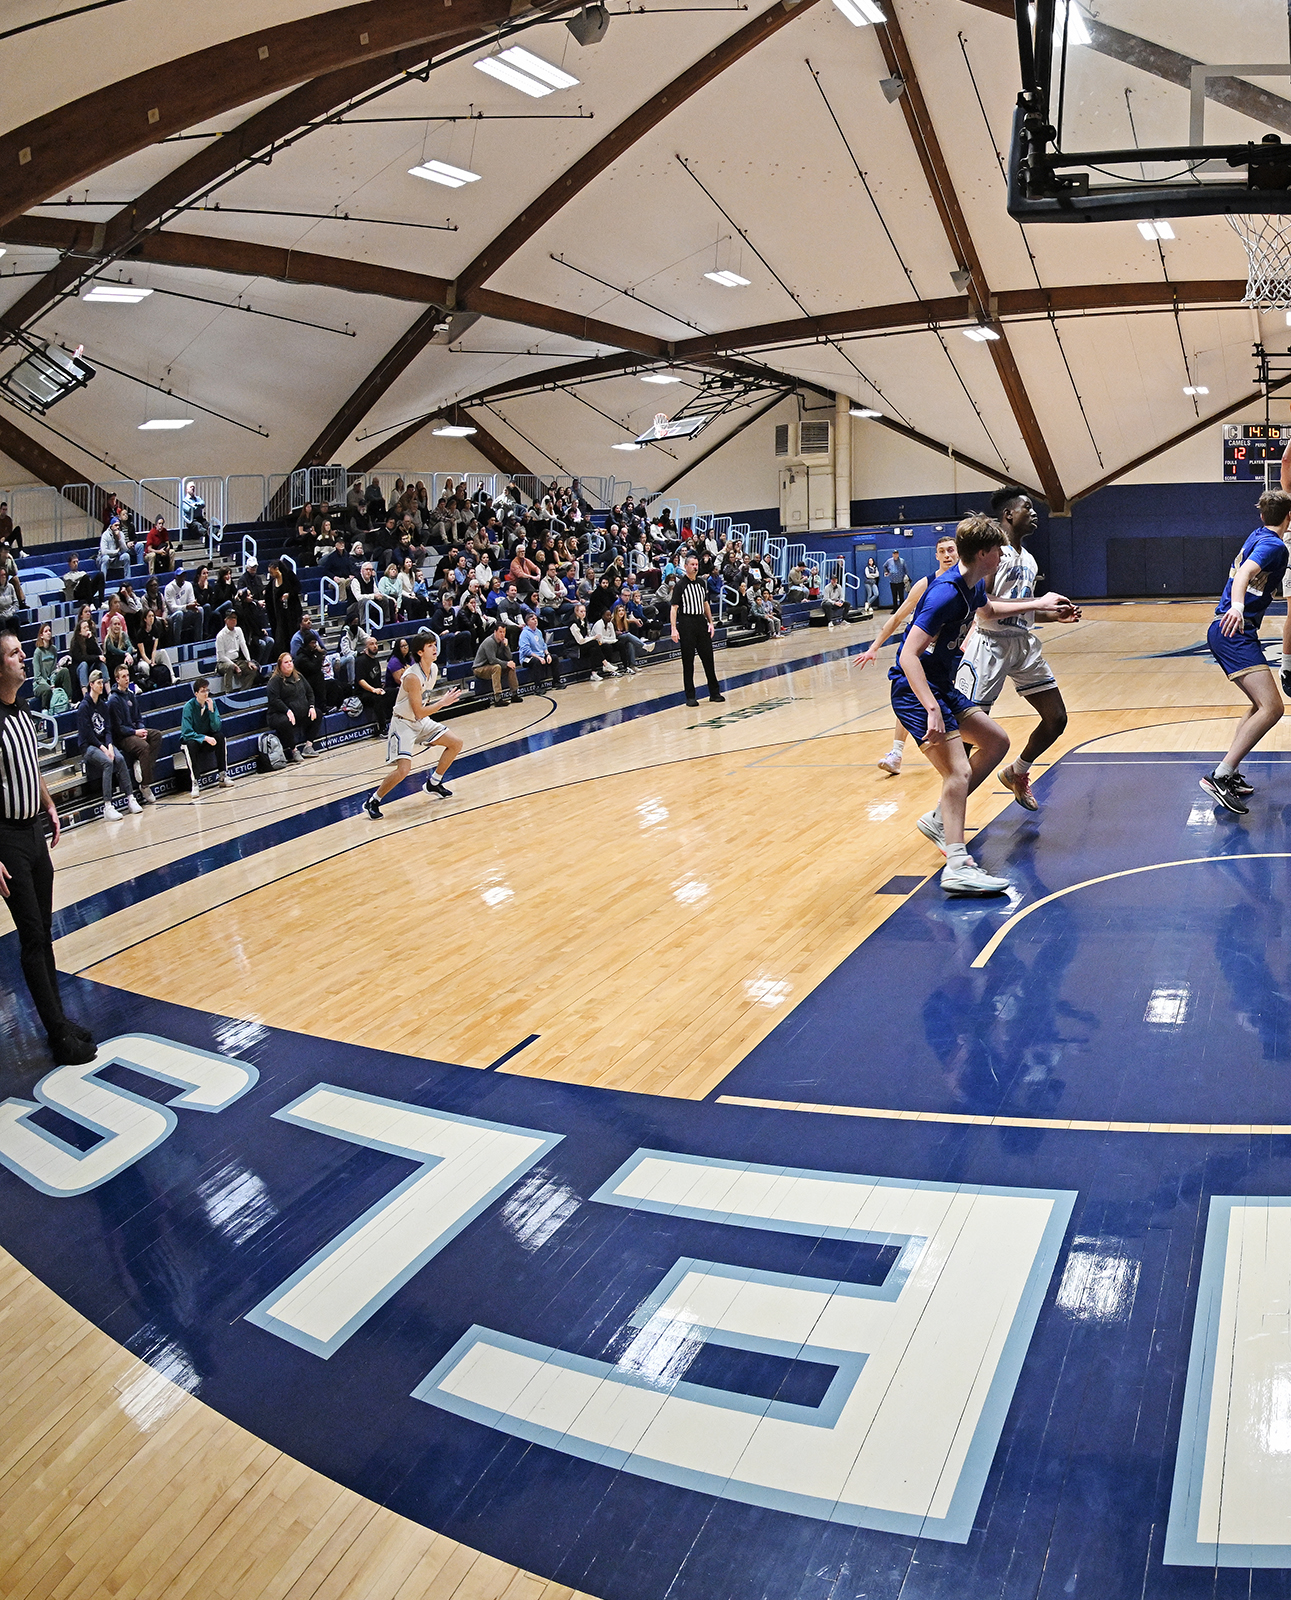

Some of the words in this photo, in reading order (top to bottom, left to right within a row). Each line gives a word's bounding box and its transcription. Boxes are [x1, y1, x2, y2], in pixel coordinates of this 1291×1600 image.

[1249, 426, 1280, 438] 14:16
[1234, 447, 1246, 460] 12
[1262, 448, 1266, 458] 1
[1232, 465, 1236, 474] 1
[215, 761, 257, 783] AHLETICS
